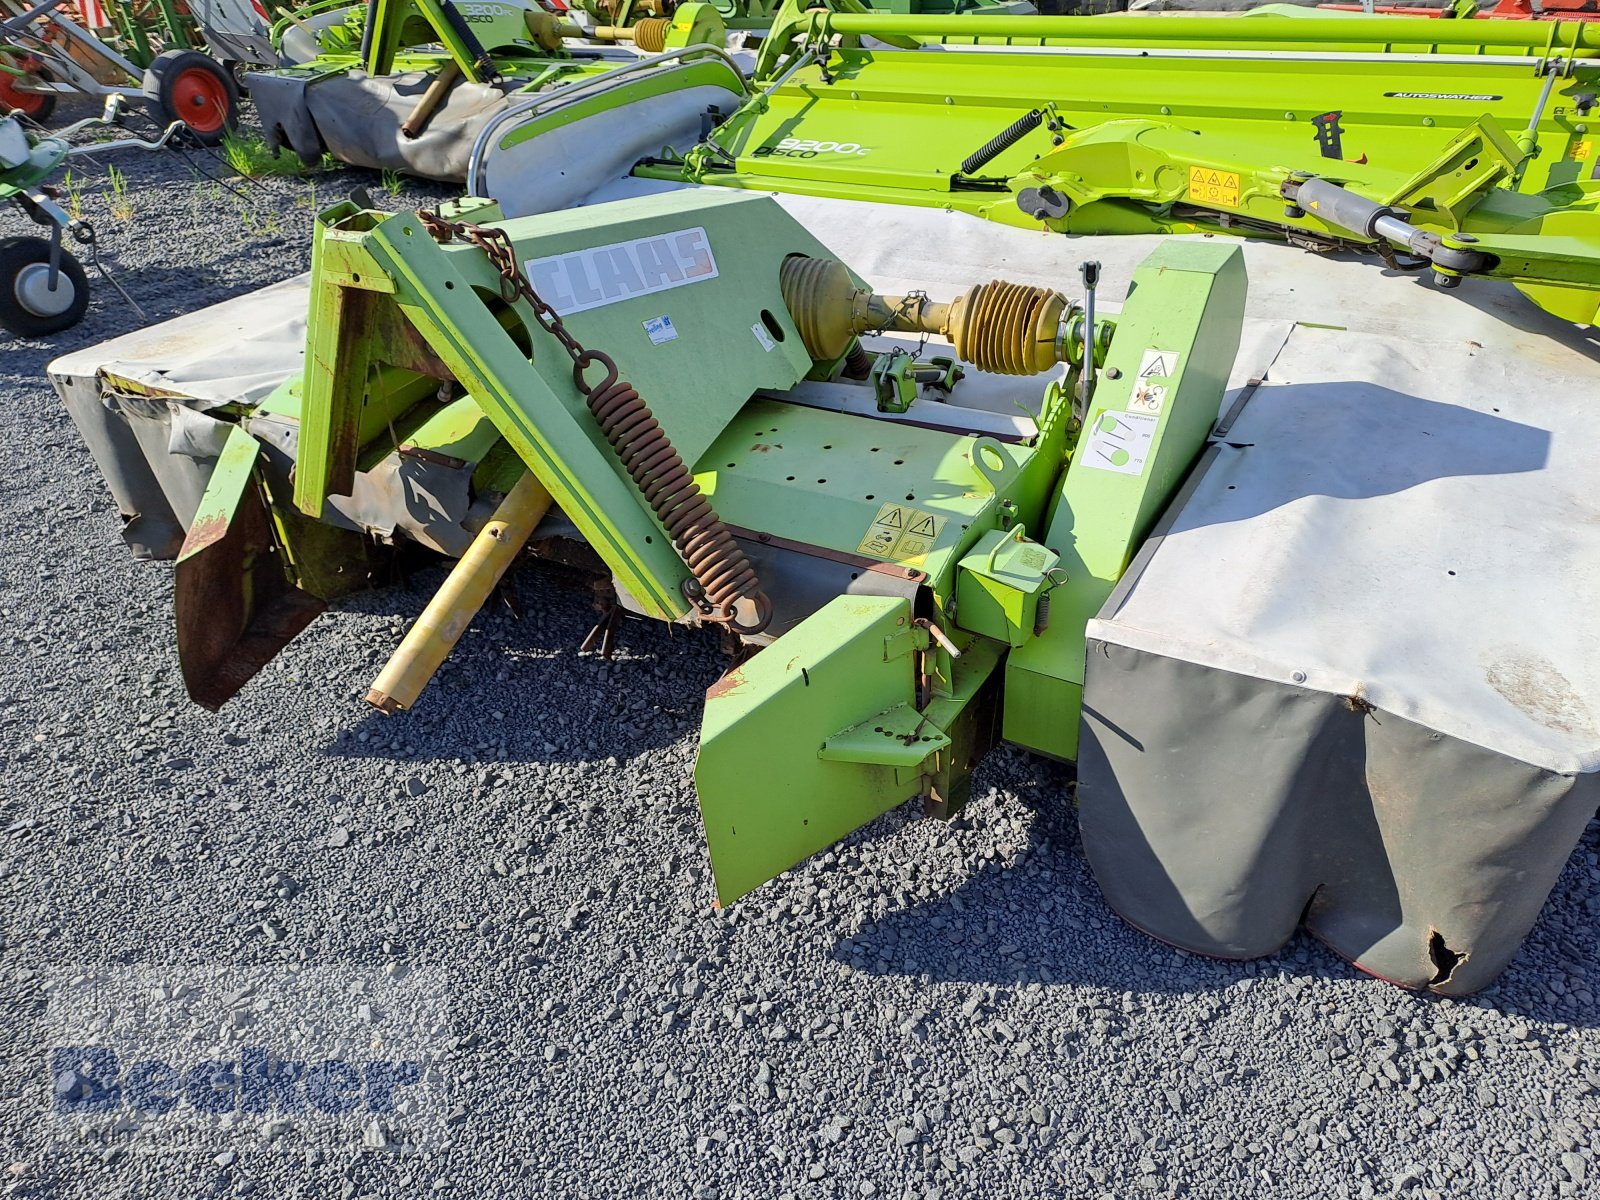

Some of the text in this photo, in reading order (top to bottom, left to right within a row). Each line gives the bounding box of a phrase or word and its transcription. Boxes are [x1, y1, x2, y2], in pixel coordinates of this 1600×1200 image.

[1392, 91, 1494, 101] AUTOSWATHER
[751, 146, 819, 159] DISCO
[530, 231, 713, 312] CLAAS
